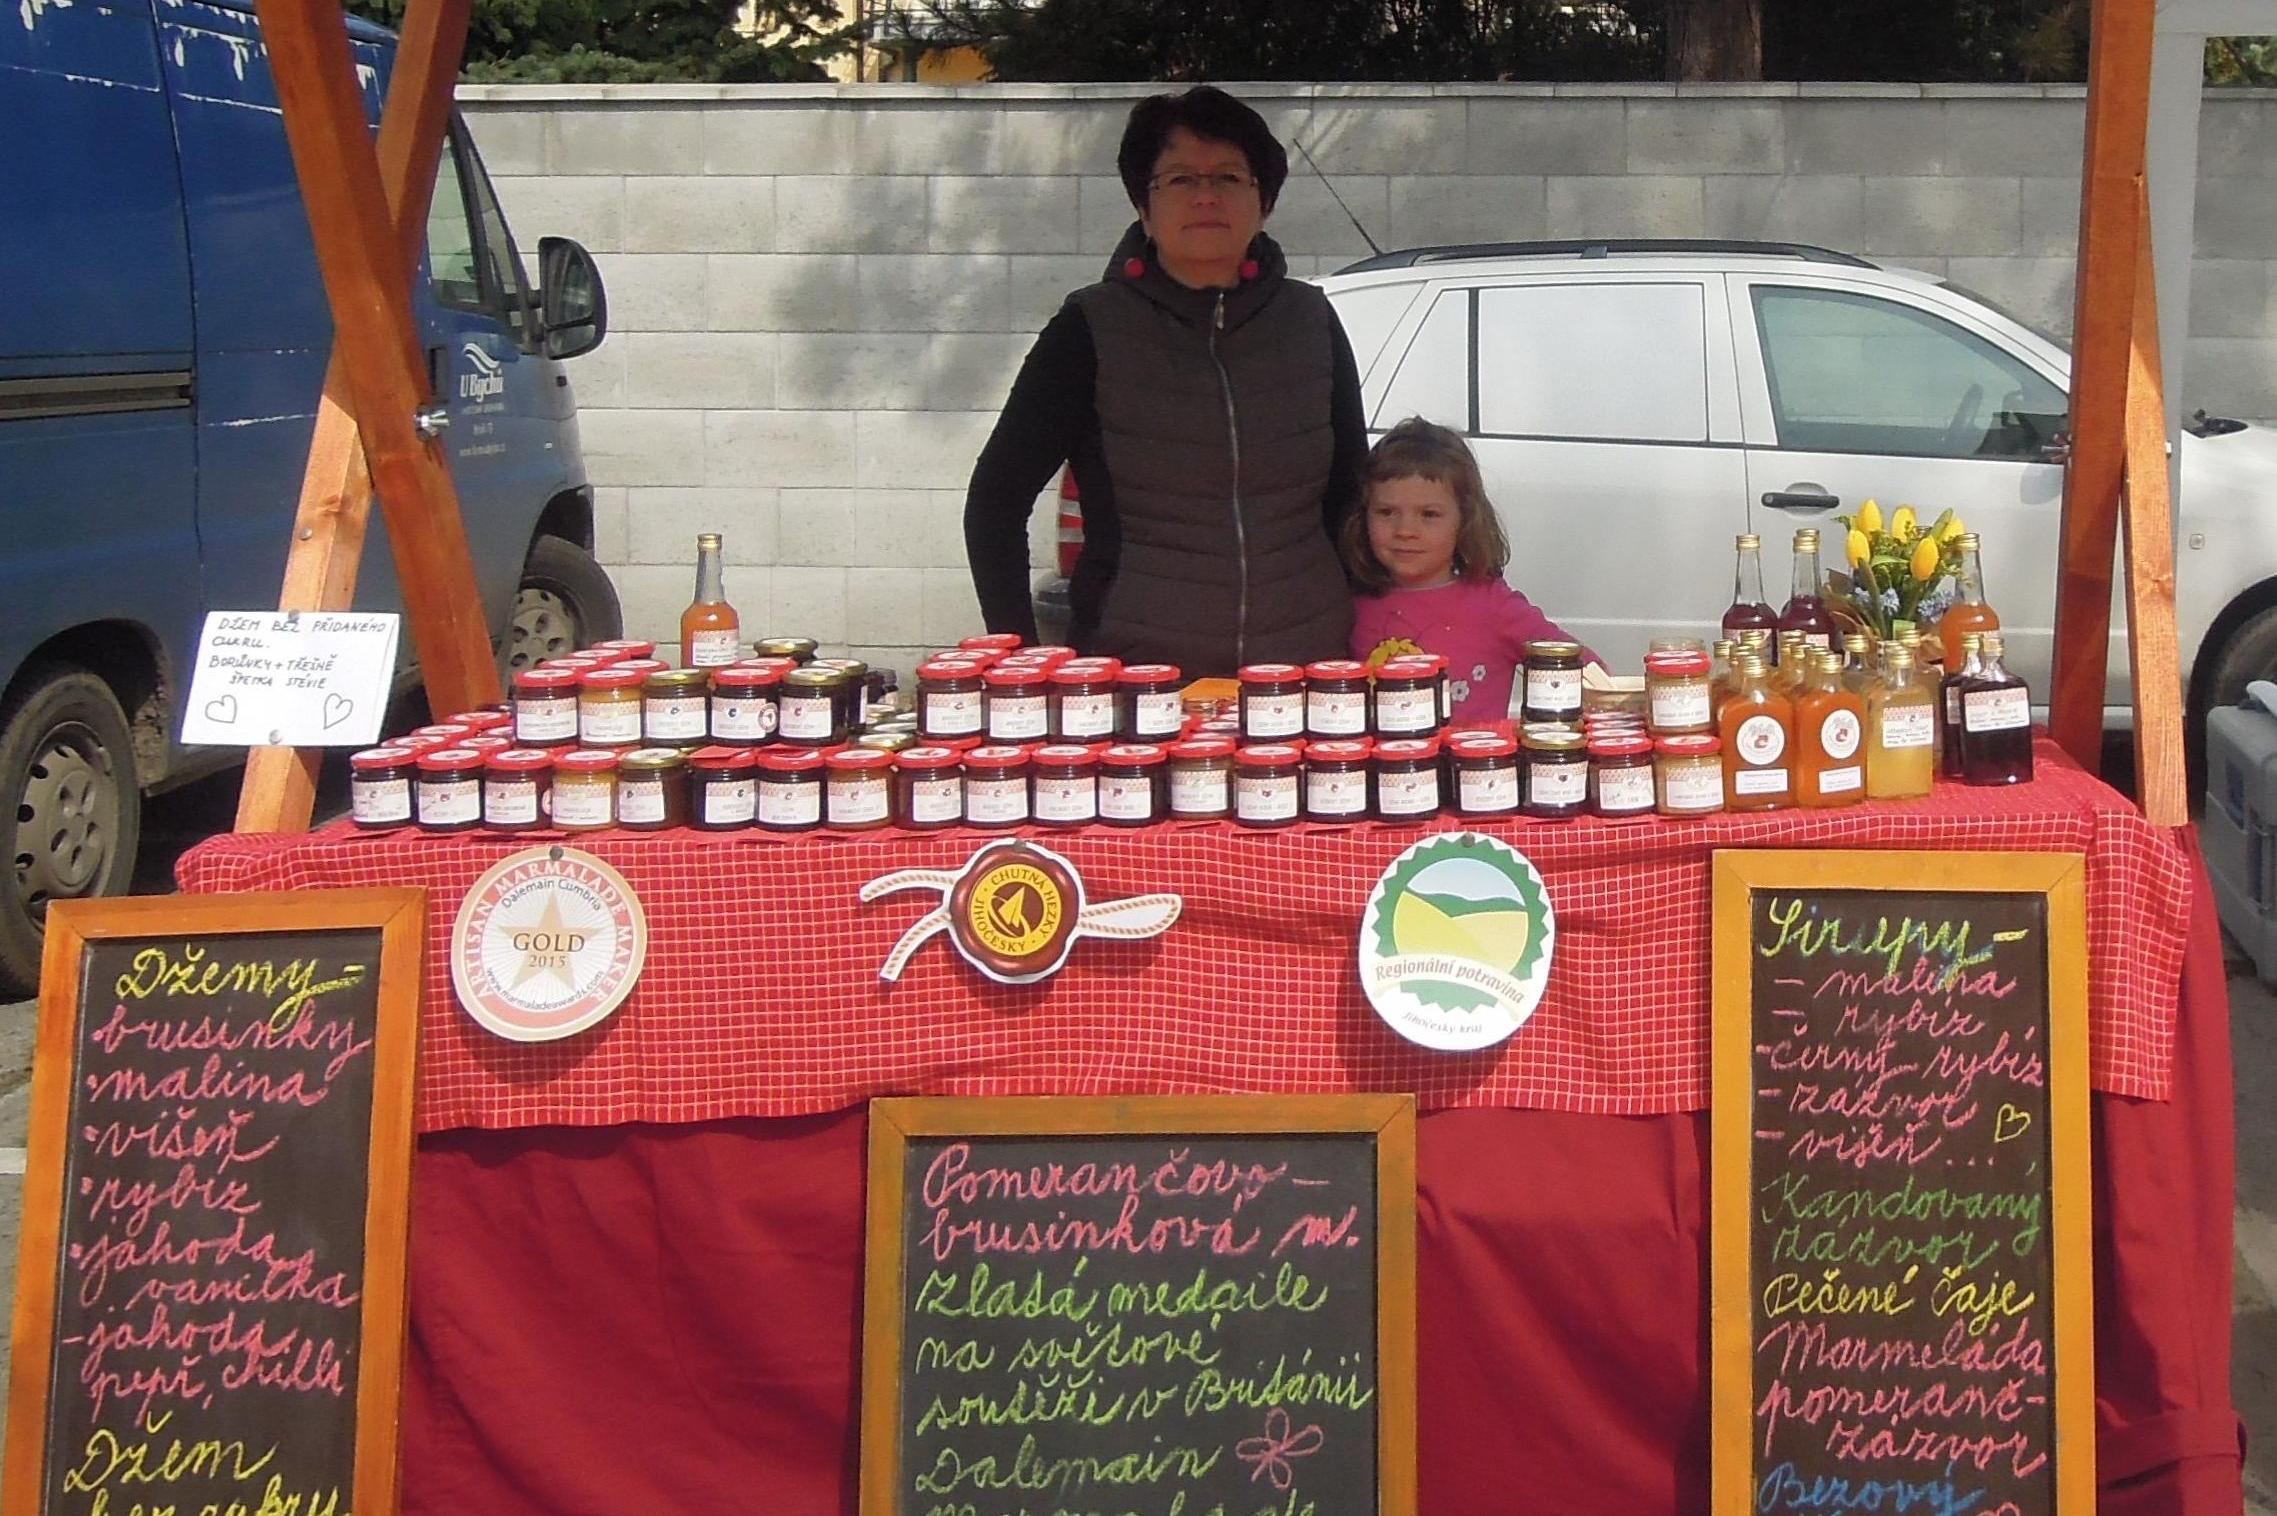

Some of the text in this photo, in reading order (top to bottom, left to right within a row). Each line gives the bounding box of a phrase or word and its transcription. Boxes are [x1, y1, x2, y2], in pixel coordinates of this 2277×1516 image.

[217, 617, 387, 633] DŽEM BEZ PŘIDANÉHO
[501, 879, 601, 912] Dalemain Cumbria
[991, 868, 1045, 889] CHUTNÁ
[1040, 890, 1057, 938] HEZKY
[465, 861, 634, 1002] ARTISAN MARMALADE MAKER
[513, 933, 585, 953] GOLD
[528, 954, 567, 968] 2015
[1759, 897, 1994, 988] Sirupy
[115, 943, 345, 1034] Džemy
[1375, 957, 1526, 1004] Regionální potravina
[1813, 956, 2017, 998] malina
[97, 1003, 373, 1083] brusinky
[90, 1052, 328, 1106] malina
[918, 1192, 1261, 1261] brusinková
[1761, 1160, 2042, 1257] Kandovaný
[79, 1215, 277, 1308] jahoda
[1772, 1213, 1999, 1271] zázvor
[1107, 1262, 1328, 1318] medaile
[1763, 1263, 1920, 1318] Pečené
[80, 1302, 298, 1383] jahoda
[915, 1336, 995, 1375] na
[1757, 1316, 2047, 1376] Marmeláda
[1125, 1384, 1178, 1422] v
[63, 1410, 281, 1493] Džem
[915, 1433, 1224, 1494] Dalemain
[1825, 1413, 2048, 1479] zázvor
[1758, 1461, 1988, 1516] Bezový
